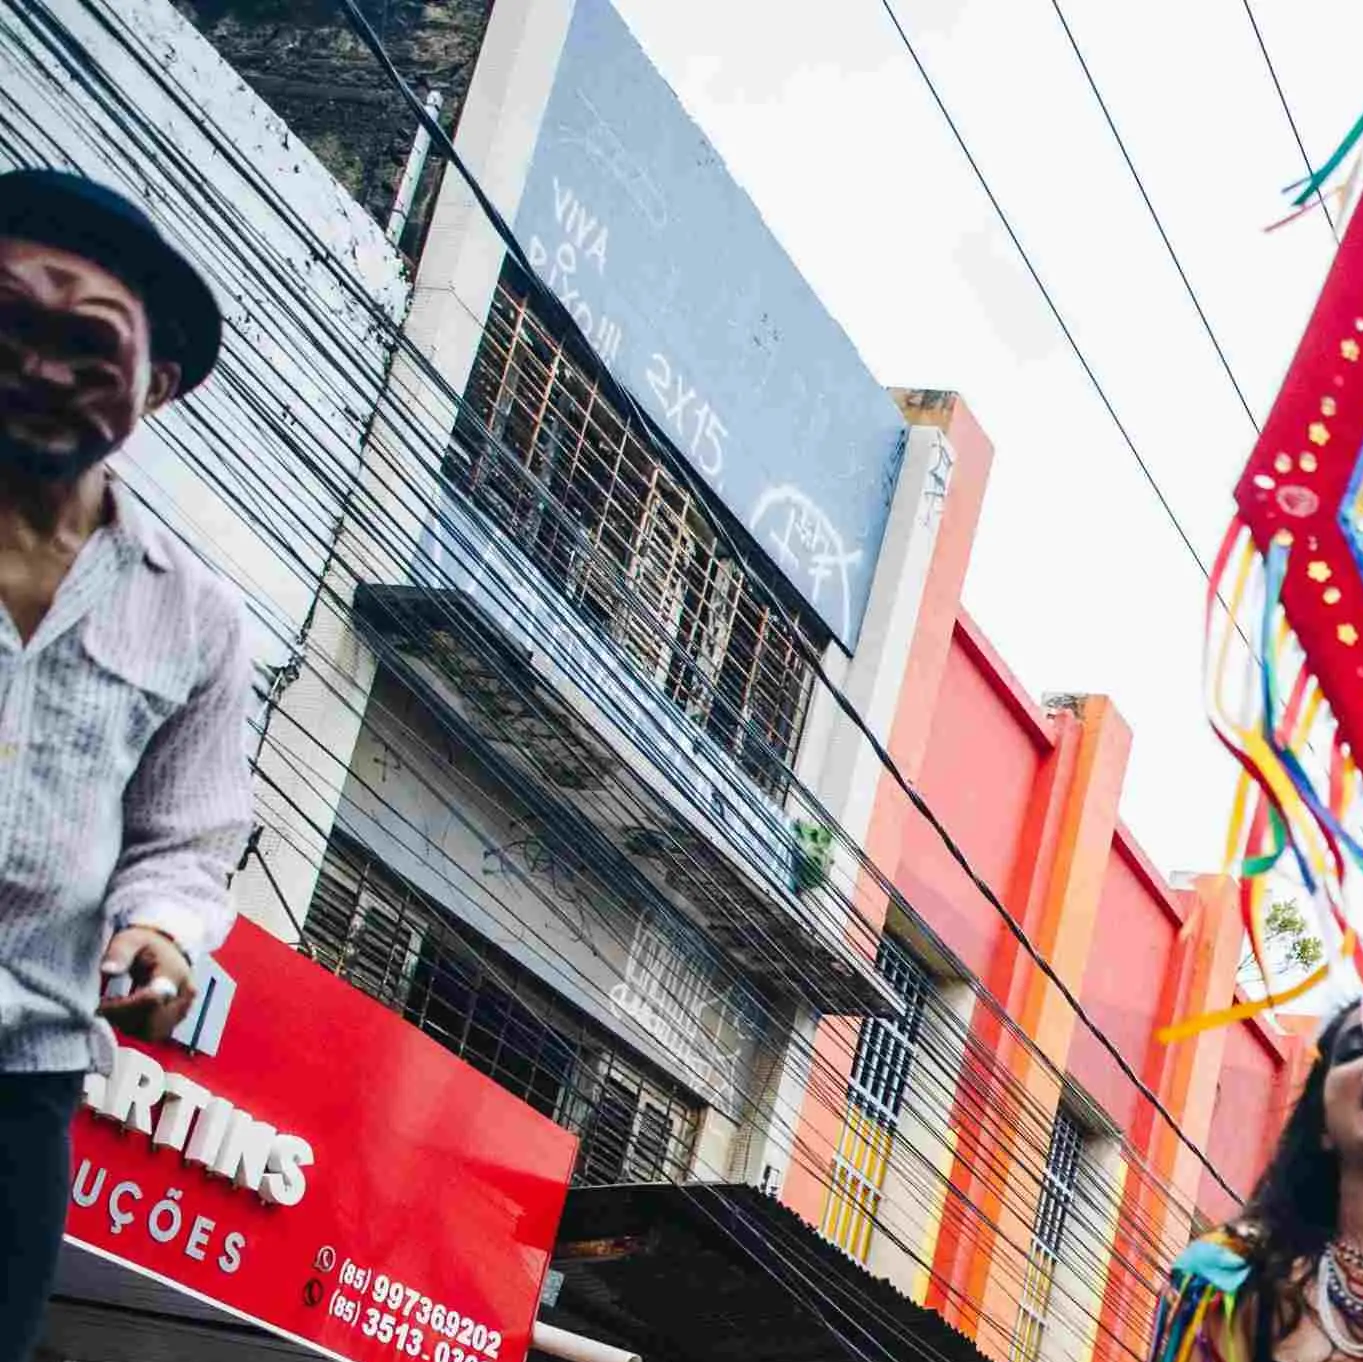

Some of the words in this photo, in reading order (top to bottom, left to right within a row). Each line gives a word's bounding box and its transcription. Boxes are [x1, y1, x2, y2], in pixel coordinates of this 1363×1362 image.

[553, 176, 609, 275] VIVA
[338, 1257, 372, 1295] (85)
[328, 1288, 361, 1328] (85)
